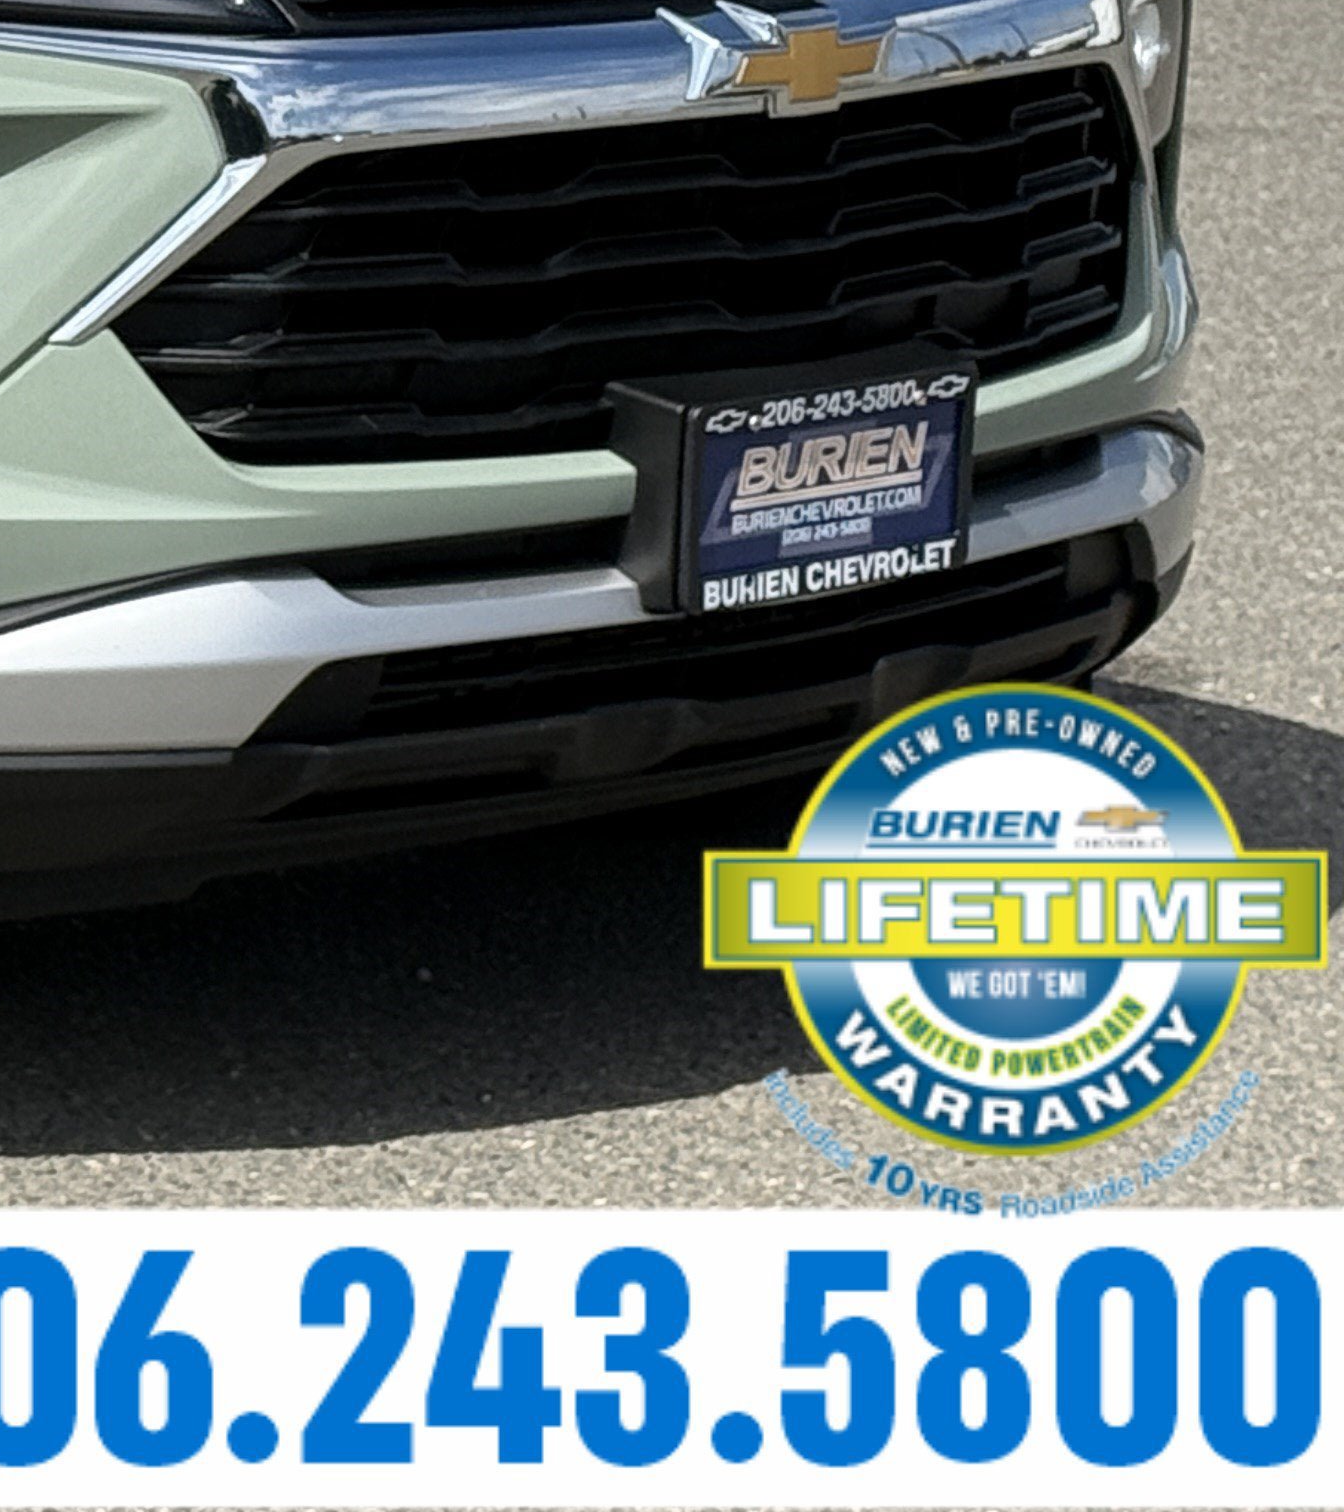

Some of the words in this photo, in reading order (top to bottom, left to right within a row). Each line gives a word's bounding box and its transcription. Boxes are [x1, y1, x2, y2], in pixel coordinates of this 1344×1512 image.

[761, 378, 918, 429] 206-243-5800
[736, 420, 930, 498] BURIEN
[805, 537, 958, 593] CHEVROLET
